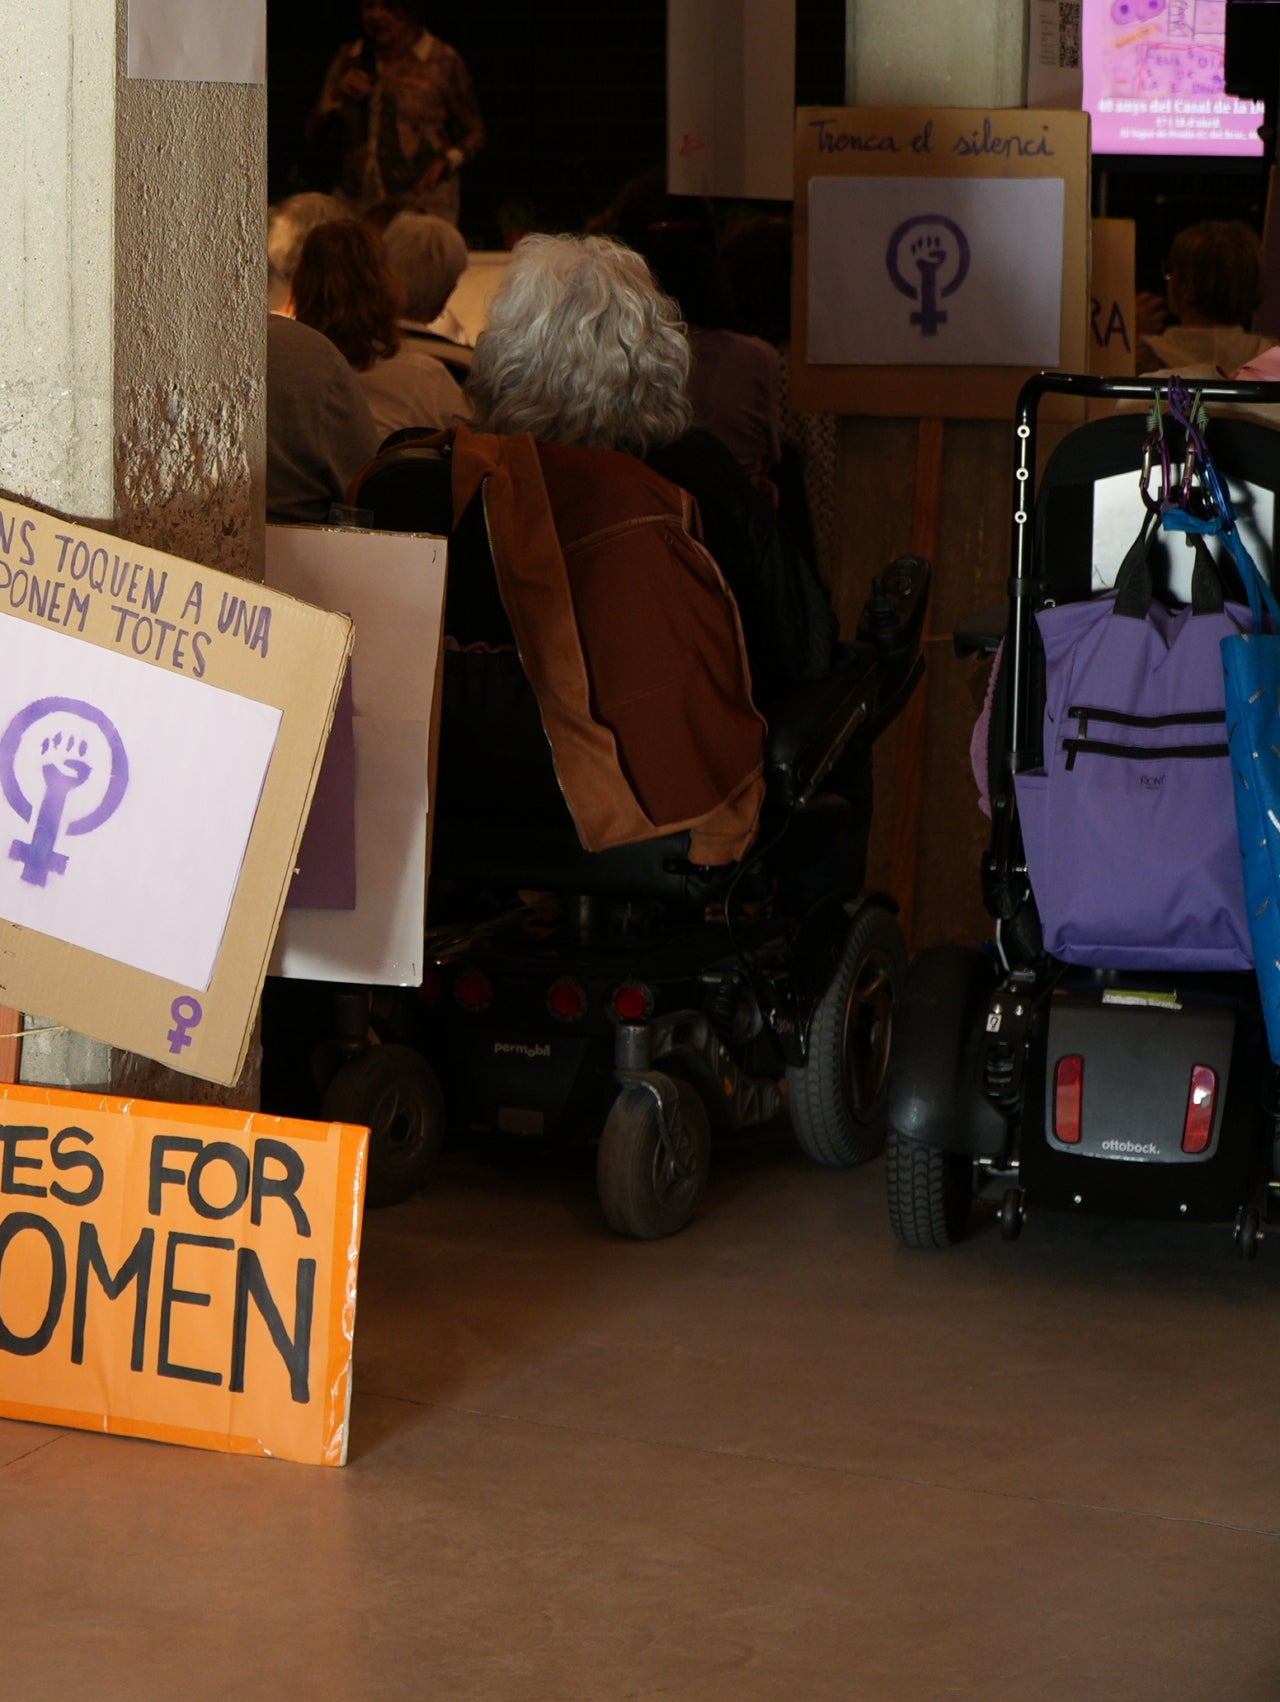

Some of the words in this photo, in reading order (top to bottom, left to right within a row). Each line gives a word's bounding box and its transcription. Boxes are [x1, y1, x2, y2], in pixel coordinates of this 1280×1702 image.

[952, 117, 1054, 158] silenci
[55, 534, 168, 614] TOQUEN
[180, 580, 203, 625] A
[217, 591, 272, 659] UNA
[110, 604, 212, 678] TOTES
[494, 1042, 551, 1058] permobil
[147, 1135, 312, 1238] FOR
